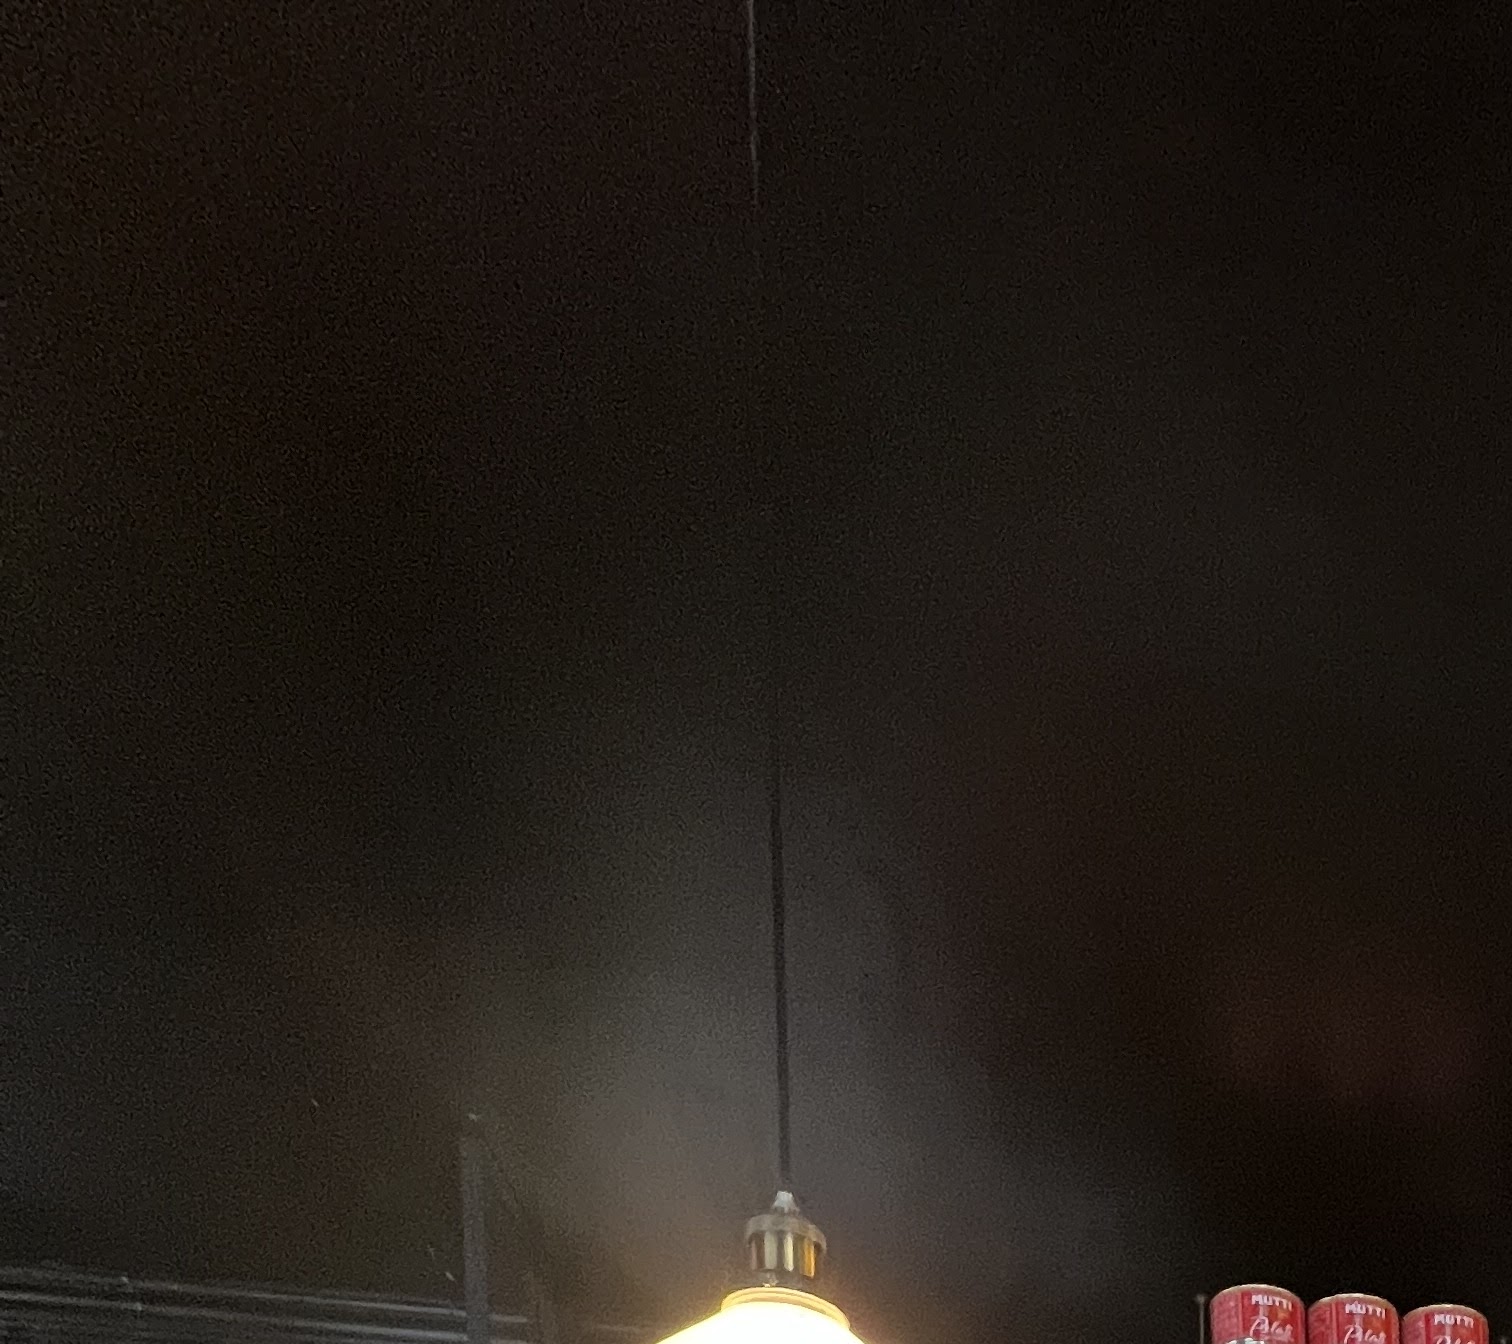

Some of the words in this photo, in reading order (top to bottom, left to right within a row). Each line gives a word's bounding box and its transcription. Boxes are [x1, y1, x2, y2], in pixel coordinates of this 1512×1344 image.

[1251, 1294, 1293, 1311] MUTTI
[1345, 1303, 1386, 1319] MUTTI
[1434, 1314, 1474, 1328] MUTTI
